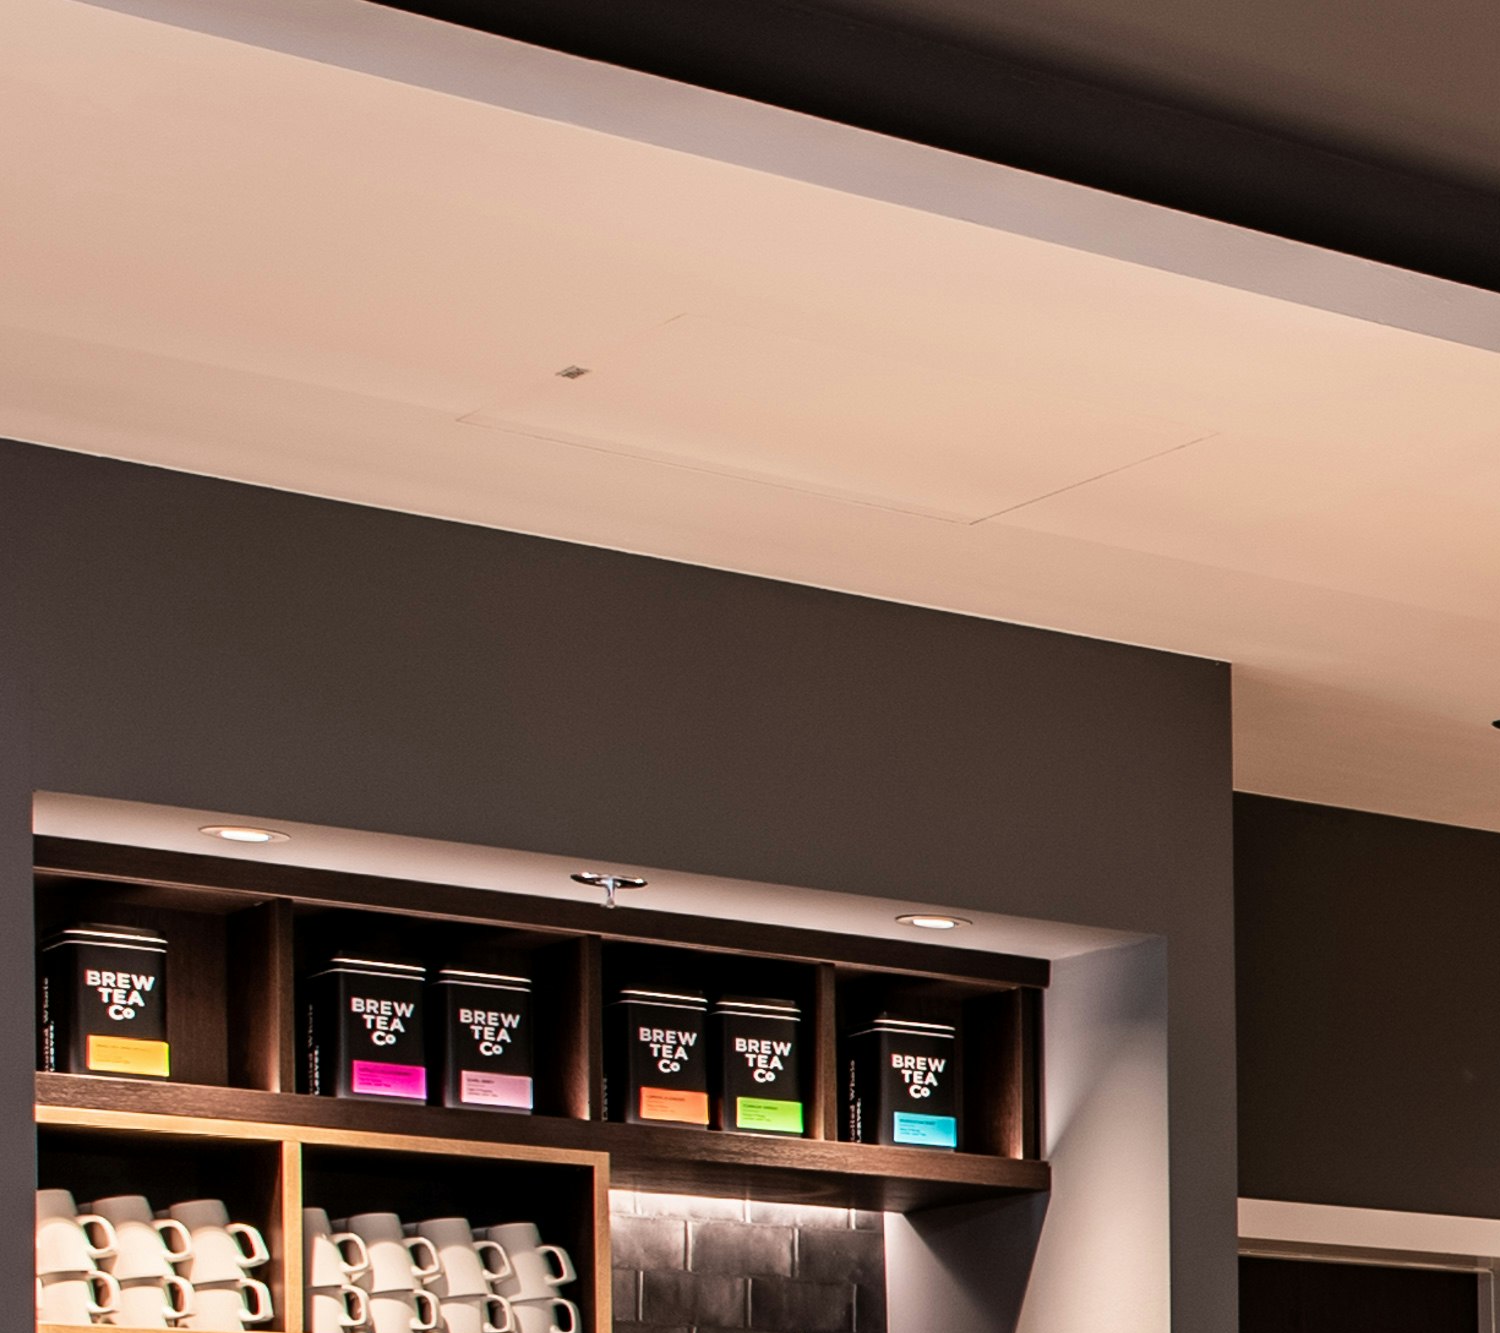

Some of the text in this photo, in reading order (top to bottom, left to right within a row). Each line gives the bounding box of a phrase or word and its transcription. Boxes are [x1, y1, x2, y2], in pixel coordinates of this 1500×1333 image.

[85, 969, 155, 992] BREW
[97, 987, 145, 1007] TEA
[350, 997, 414, 1018] BREW
[362, 1014, 405, 1033] TEA
[459, 1008, 520, 1029] BREW
[469, 1025, 512, 1043] TEA
[638, 1027, 698, 1047] BREW
[649, 1043, 689, 1061] TEA
[735, 1037, 792, 1057] BREW
[744, 1053, 784, 1071] TEA
[891, 1053, 946, 1073] BREW
[901, 1069, 938, 1087] TEA
